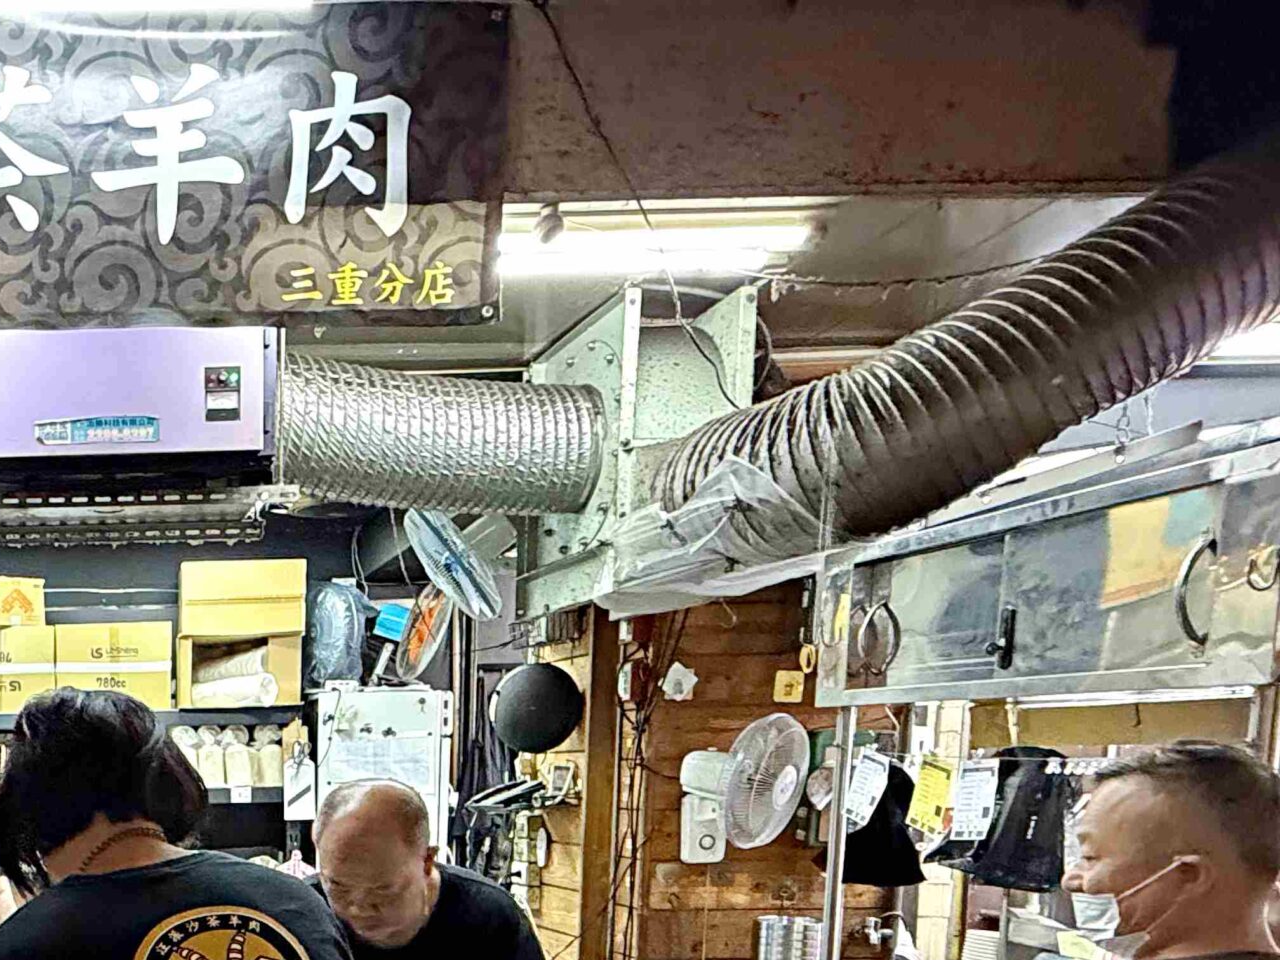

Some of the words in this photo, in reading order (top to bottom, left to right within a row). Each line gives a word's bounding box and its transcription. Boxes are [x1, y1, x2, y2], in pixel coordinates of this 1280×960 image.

[280, 260, 455, 307] 三重分店
[96, 677, 126, 688] 780cc
